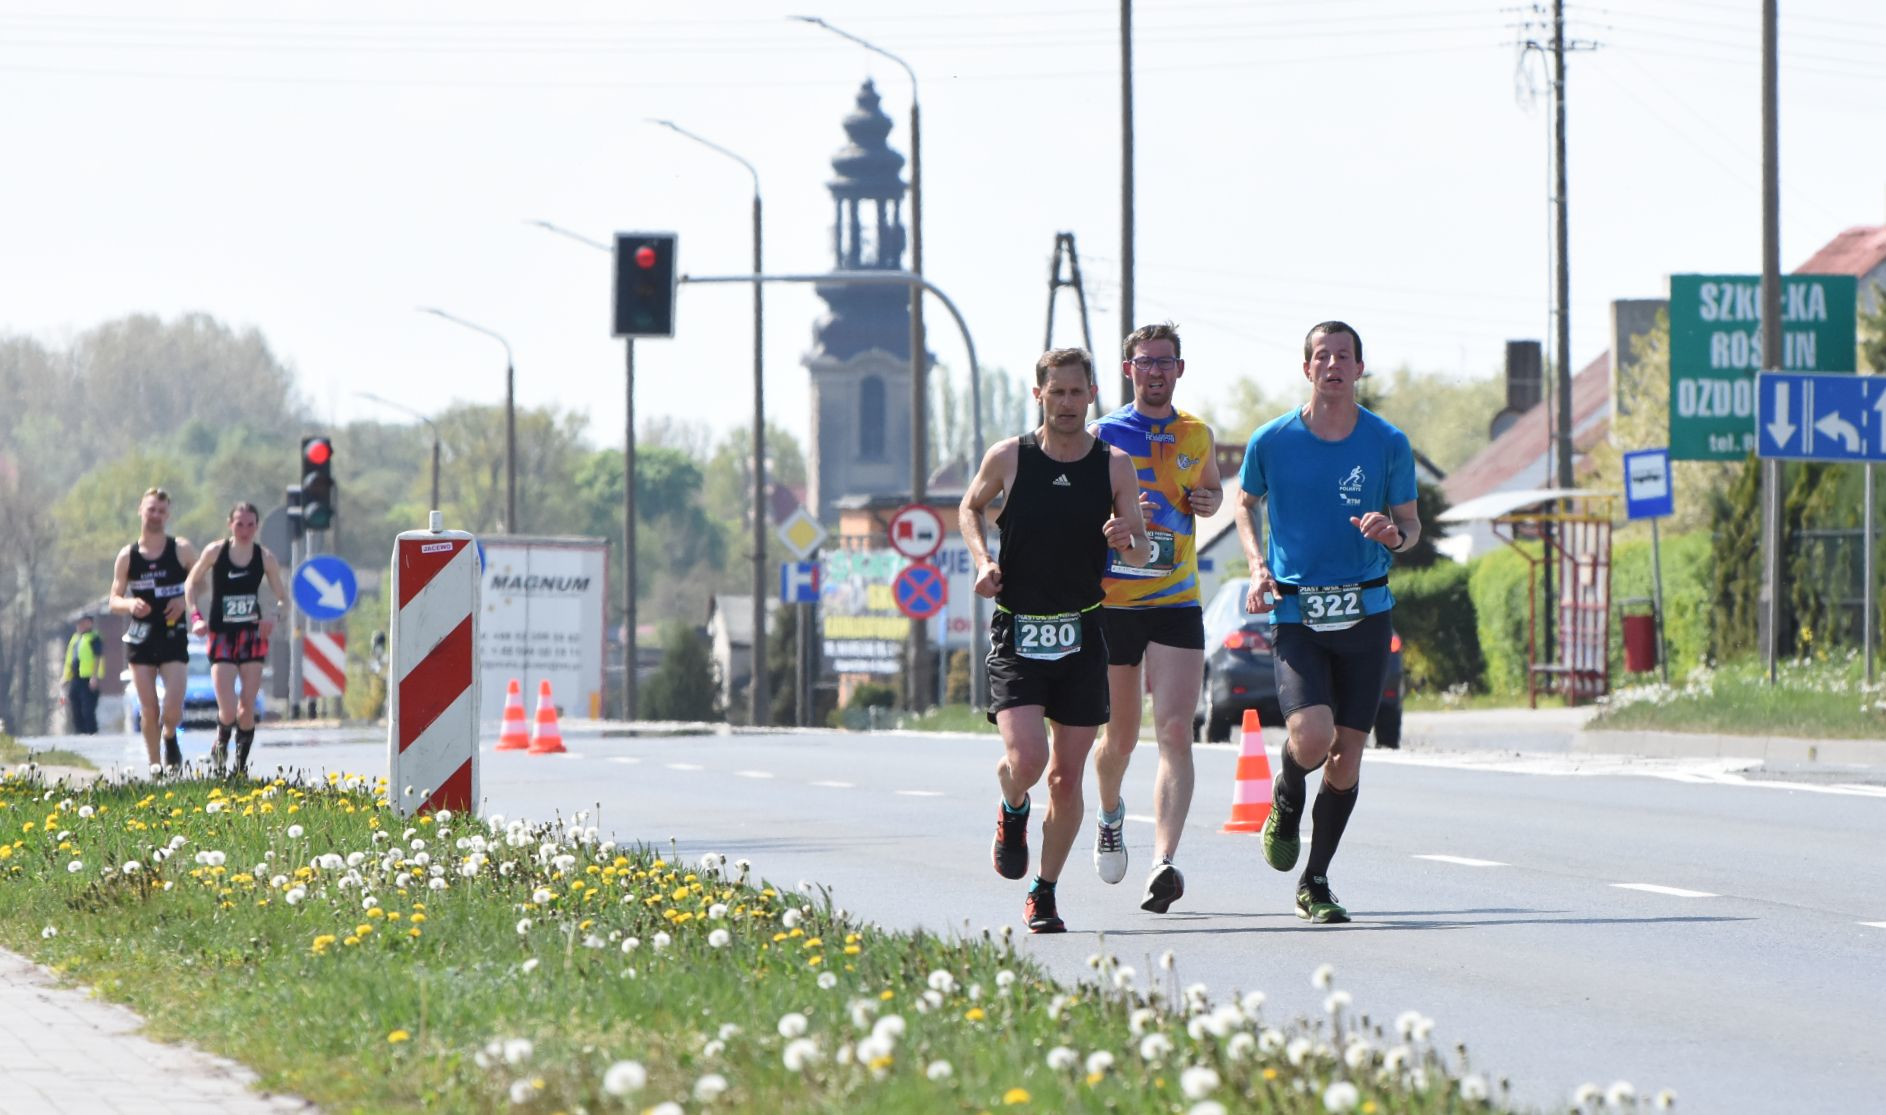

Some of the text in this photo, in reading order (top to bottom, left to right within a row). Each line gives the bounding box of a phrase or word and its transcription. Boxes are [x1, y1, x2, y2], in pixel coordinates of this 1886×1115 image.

[1711, 322, 1816, 369] ROŚIN
[1678, 377, 1757, 418] OZDO
[1708, 432, 1741, 453] tel.
[490, 575, 591, 593] MAGNUM
[226, 601, 256, 616] 287
[1307, 592, 1360, 618] 322
[1021, 623, 1076, 647] 280
